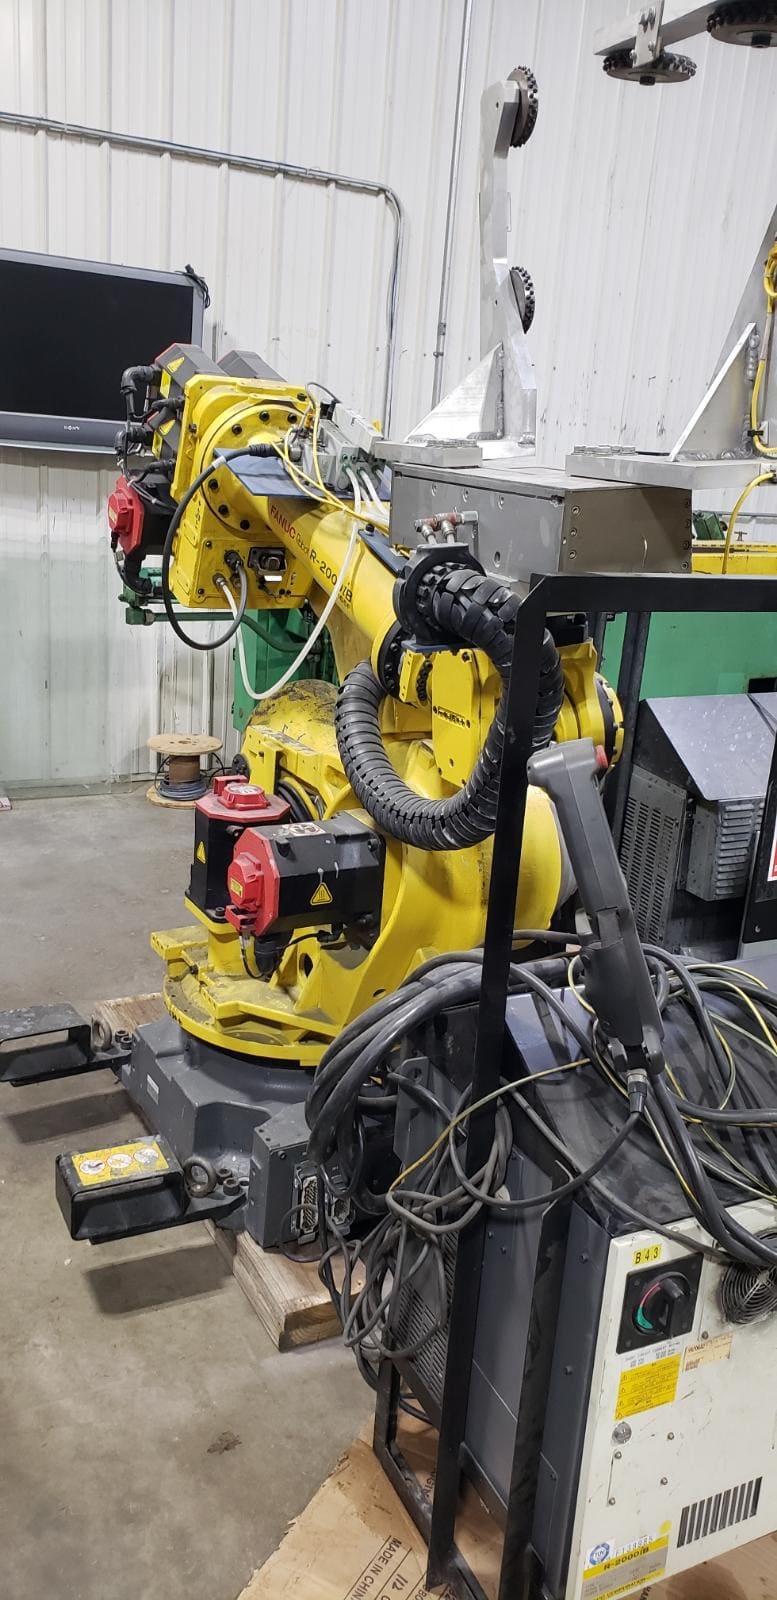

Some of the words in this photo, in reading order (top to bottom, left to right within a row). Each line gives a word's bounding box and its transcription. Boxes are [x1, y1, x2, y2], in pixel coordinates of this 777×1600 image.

[270, 505, 296, 539] FANUC
[378, 1537, 402, 1565] MADE
[369, 1562, 384, 1576] IN
[351, 1575, 374, 1600] CHIN
